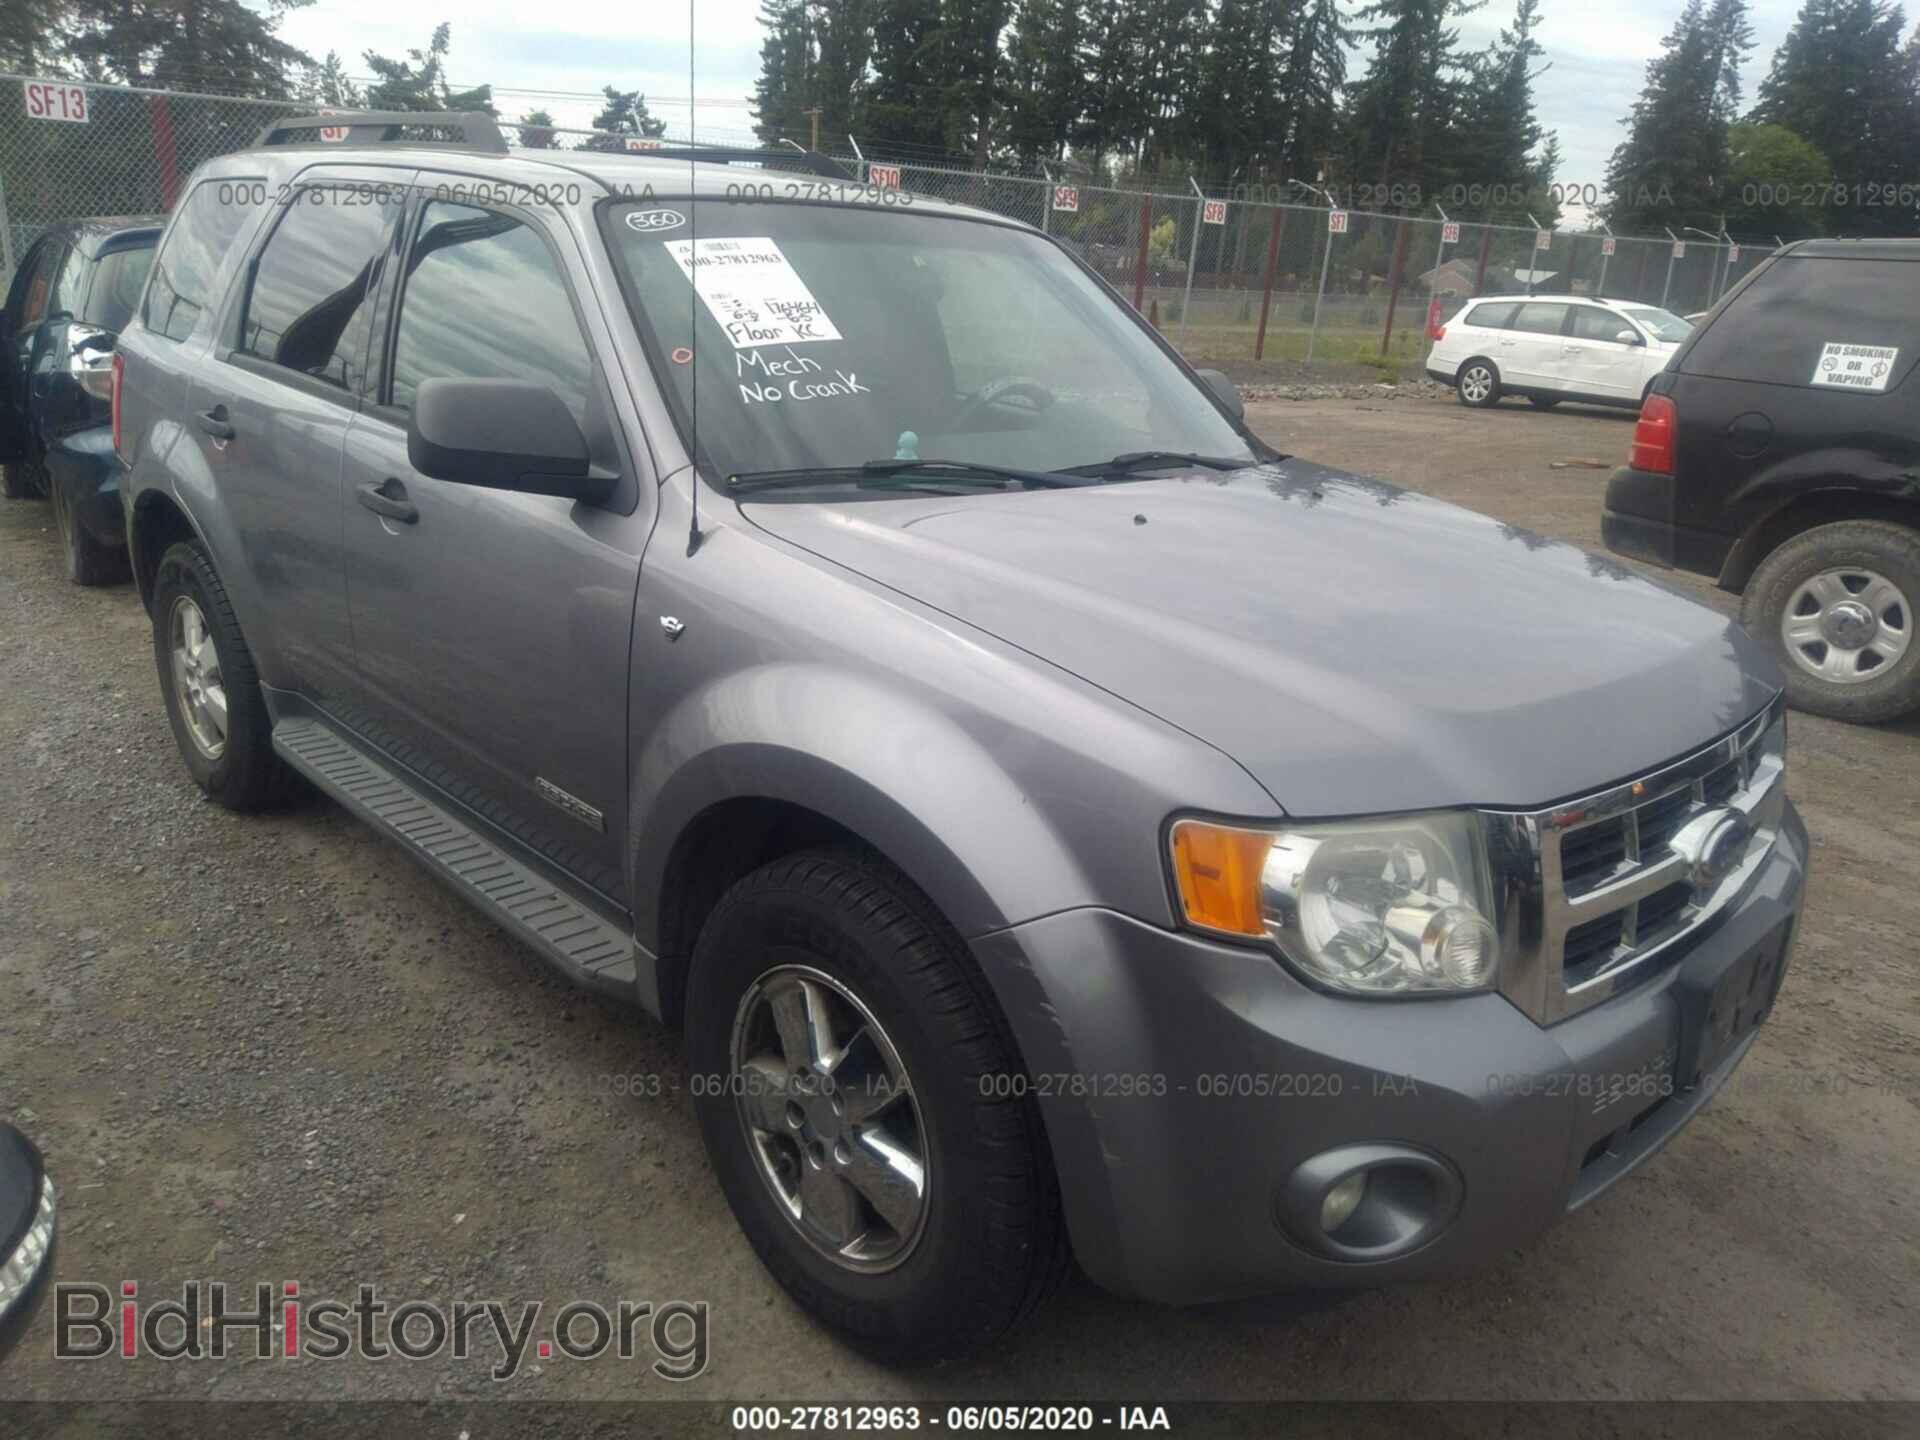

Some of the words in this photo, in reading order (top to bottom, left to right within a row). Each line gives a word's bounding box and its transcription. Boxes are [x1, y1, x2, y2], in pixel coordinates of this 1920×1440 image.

[28, 84, 85, 119] SF13
[871, 167, 898, 190] SF10
[1055, 188, 1078, 209] SF9
[632, 212, 678, 228] 360
[1206, 202, 1224, 221] SF8
[683, 253, 782, 268] 000-27812963
[726, 322, 784, 344] Floor
[735, 345, 822, 377] Mech
[1825, 345, 1841, 355] NO
[1842, 345, 1894, 359] SMOKING
[1847, 361, 1863, 371] OR
[739, 381, 782, 403] No
[788, 370, 871, 401] Crank
[1827, 373, 1873, 386] VAPING
